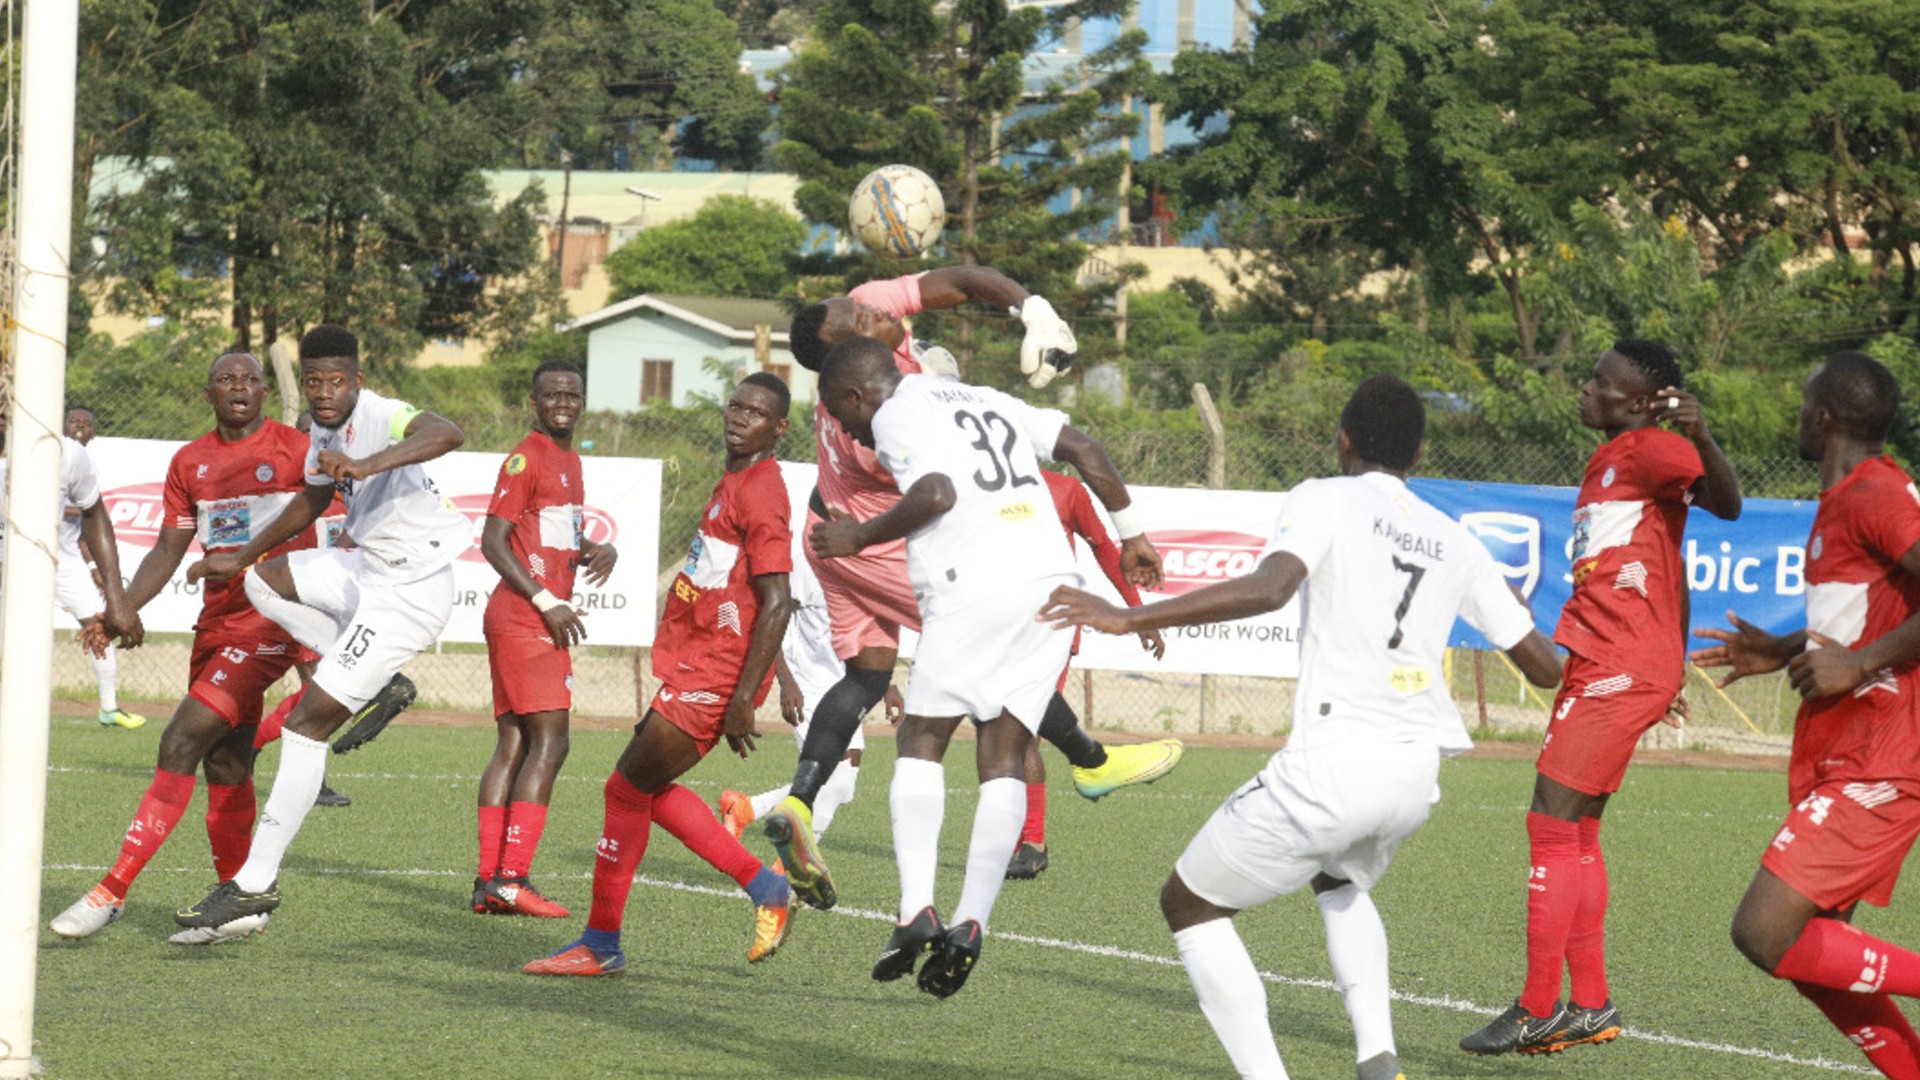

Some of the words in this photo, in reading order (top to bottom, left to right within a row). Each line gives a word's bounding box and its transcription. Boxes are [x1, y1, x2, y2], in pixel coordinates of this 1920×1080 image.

[954, 408, 1039, 492] 32
[572, 592, 627, 610] ORLD
[1387, 553, 1427, 650] 7
[344, 623, 377, 658] 15
[1555, 696, 1578, 721] 3
